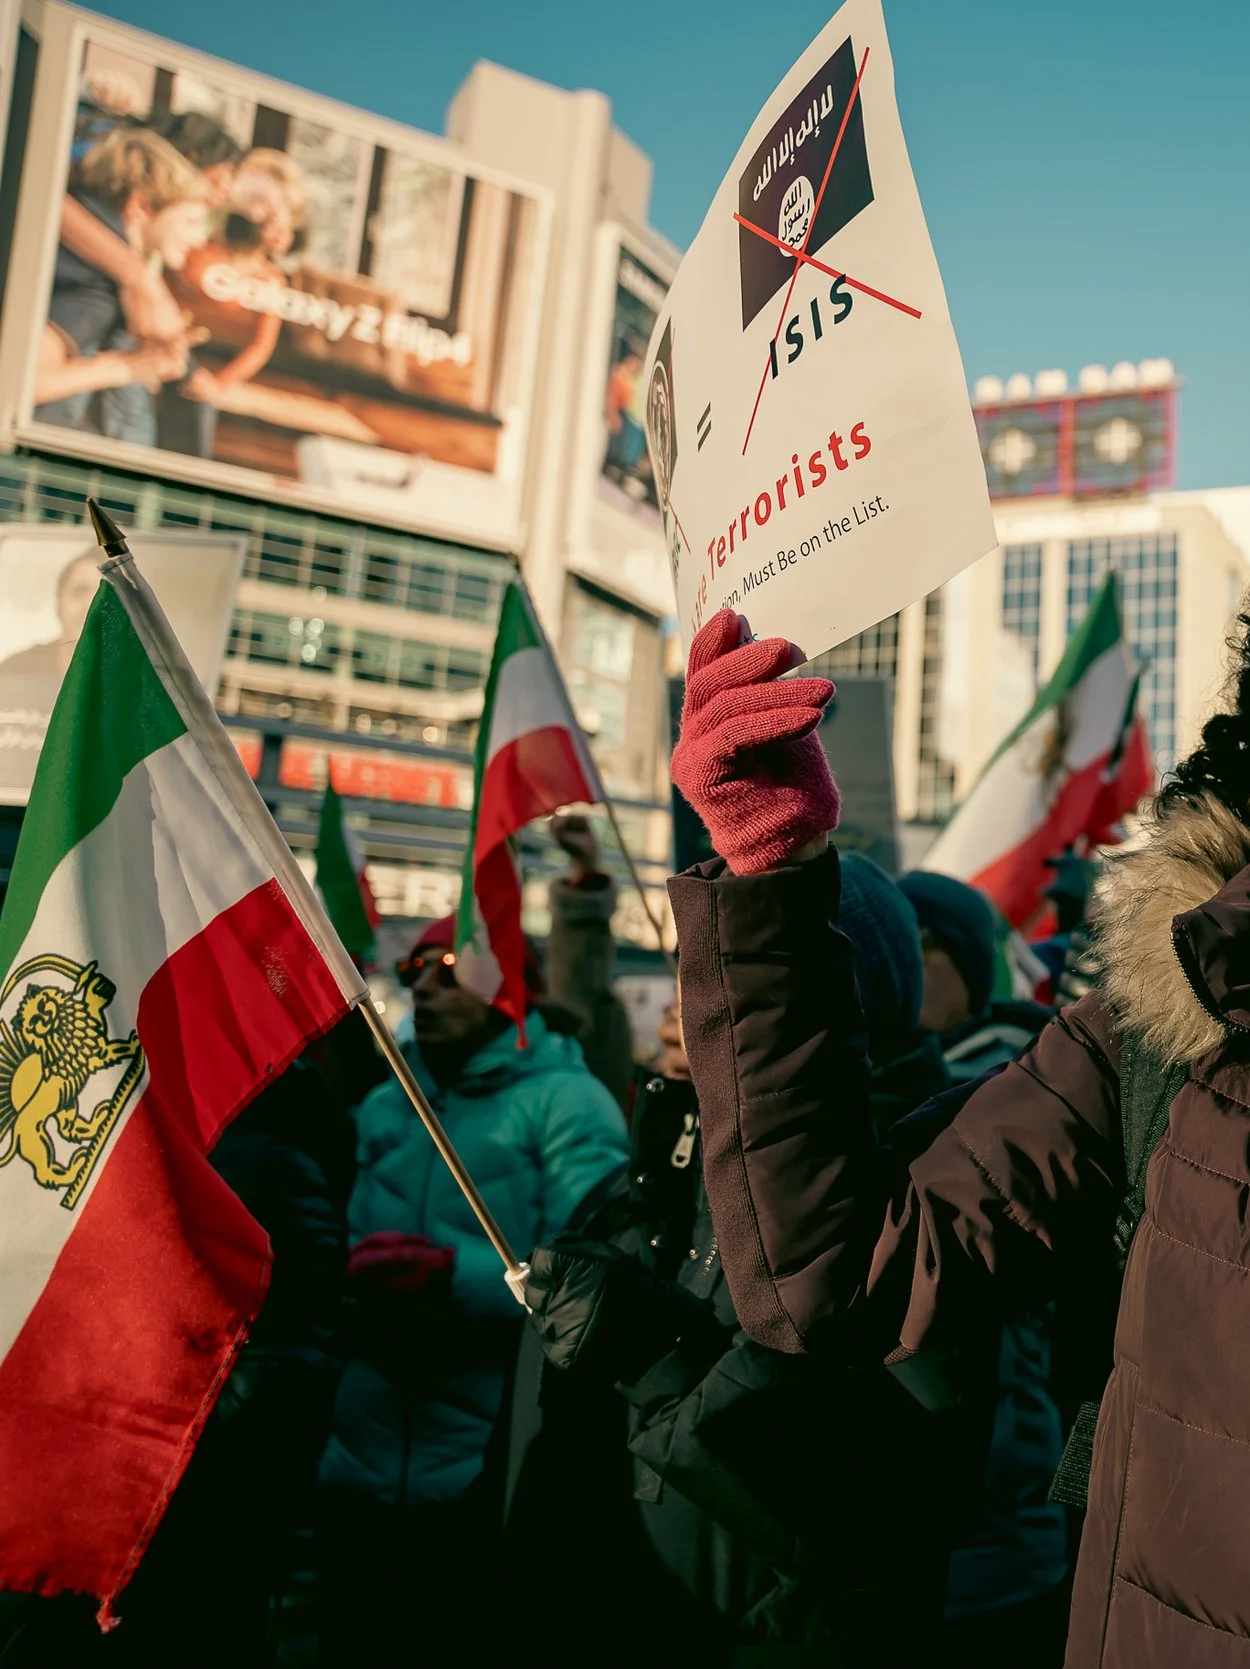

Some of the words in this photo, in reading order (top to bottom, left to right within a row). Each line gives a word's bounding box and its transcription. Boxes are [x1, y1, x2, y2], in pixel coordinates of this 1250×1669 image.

[769, 273, 855, 380] ISIS
[707, 421, 873, 579] Terrorists
[741, 547, 777, 596] Must
[776, 550, 798, 573] Be
[799, 535, 822, 558] on
[822, 512, 854, 544] the
[852, 492, 890, 527] List.
